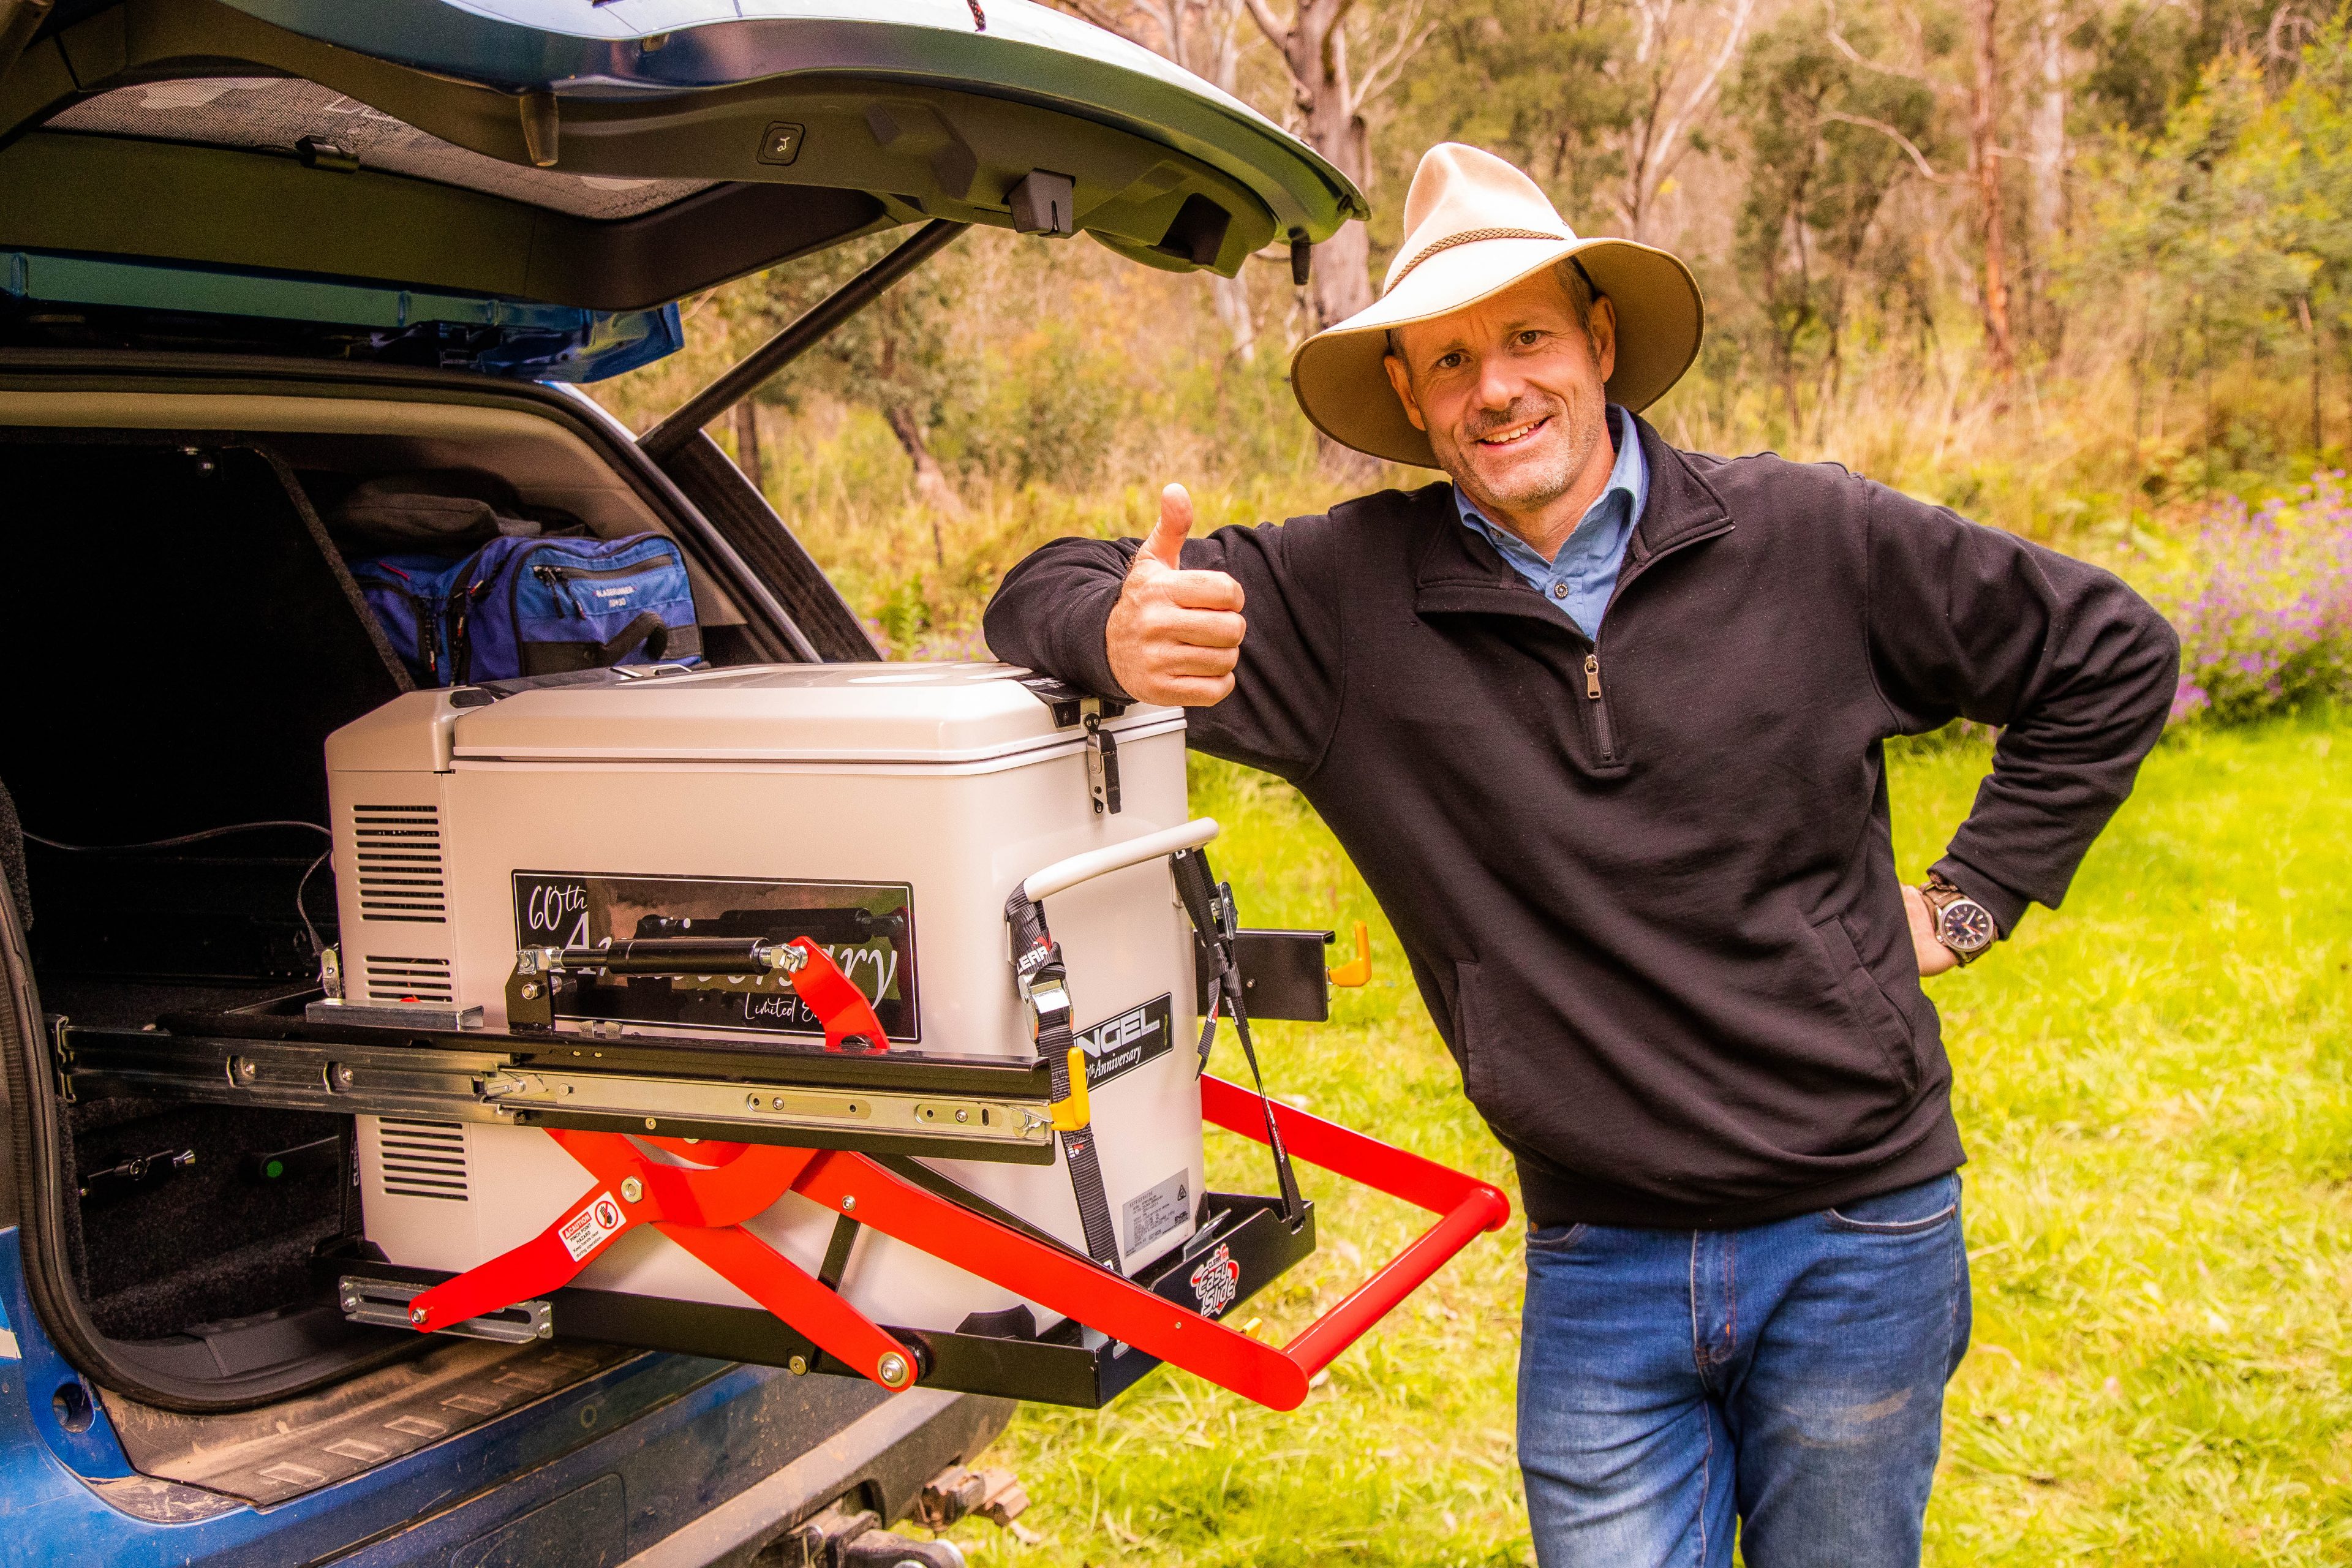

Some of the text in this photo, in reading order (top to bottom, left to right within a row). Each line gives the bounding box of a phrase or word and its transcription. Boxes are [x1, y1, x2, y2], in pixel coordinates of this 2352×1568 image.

[529, 884, 587, 930] 60th
[745, 992, 796, 1022] Limited
[1073, 1008, 1159, 1058] NGEL
[1094, 1046, 1141, 1079] Anniversary
[568, 1213, 590, 1234] CAUTION
[570, 1223, 592, 1242] PINCH POINT
[576, 1231, 591, 1244] HAZARD
[573, 1244, 582, 1253] Keep
[581, 1237, 592, 1247] hands
[1199, 1261, 1229, 1297] Easy
[1203, 1278, 1235, 1316] Slide
